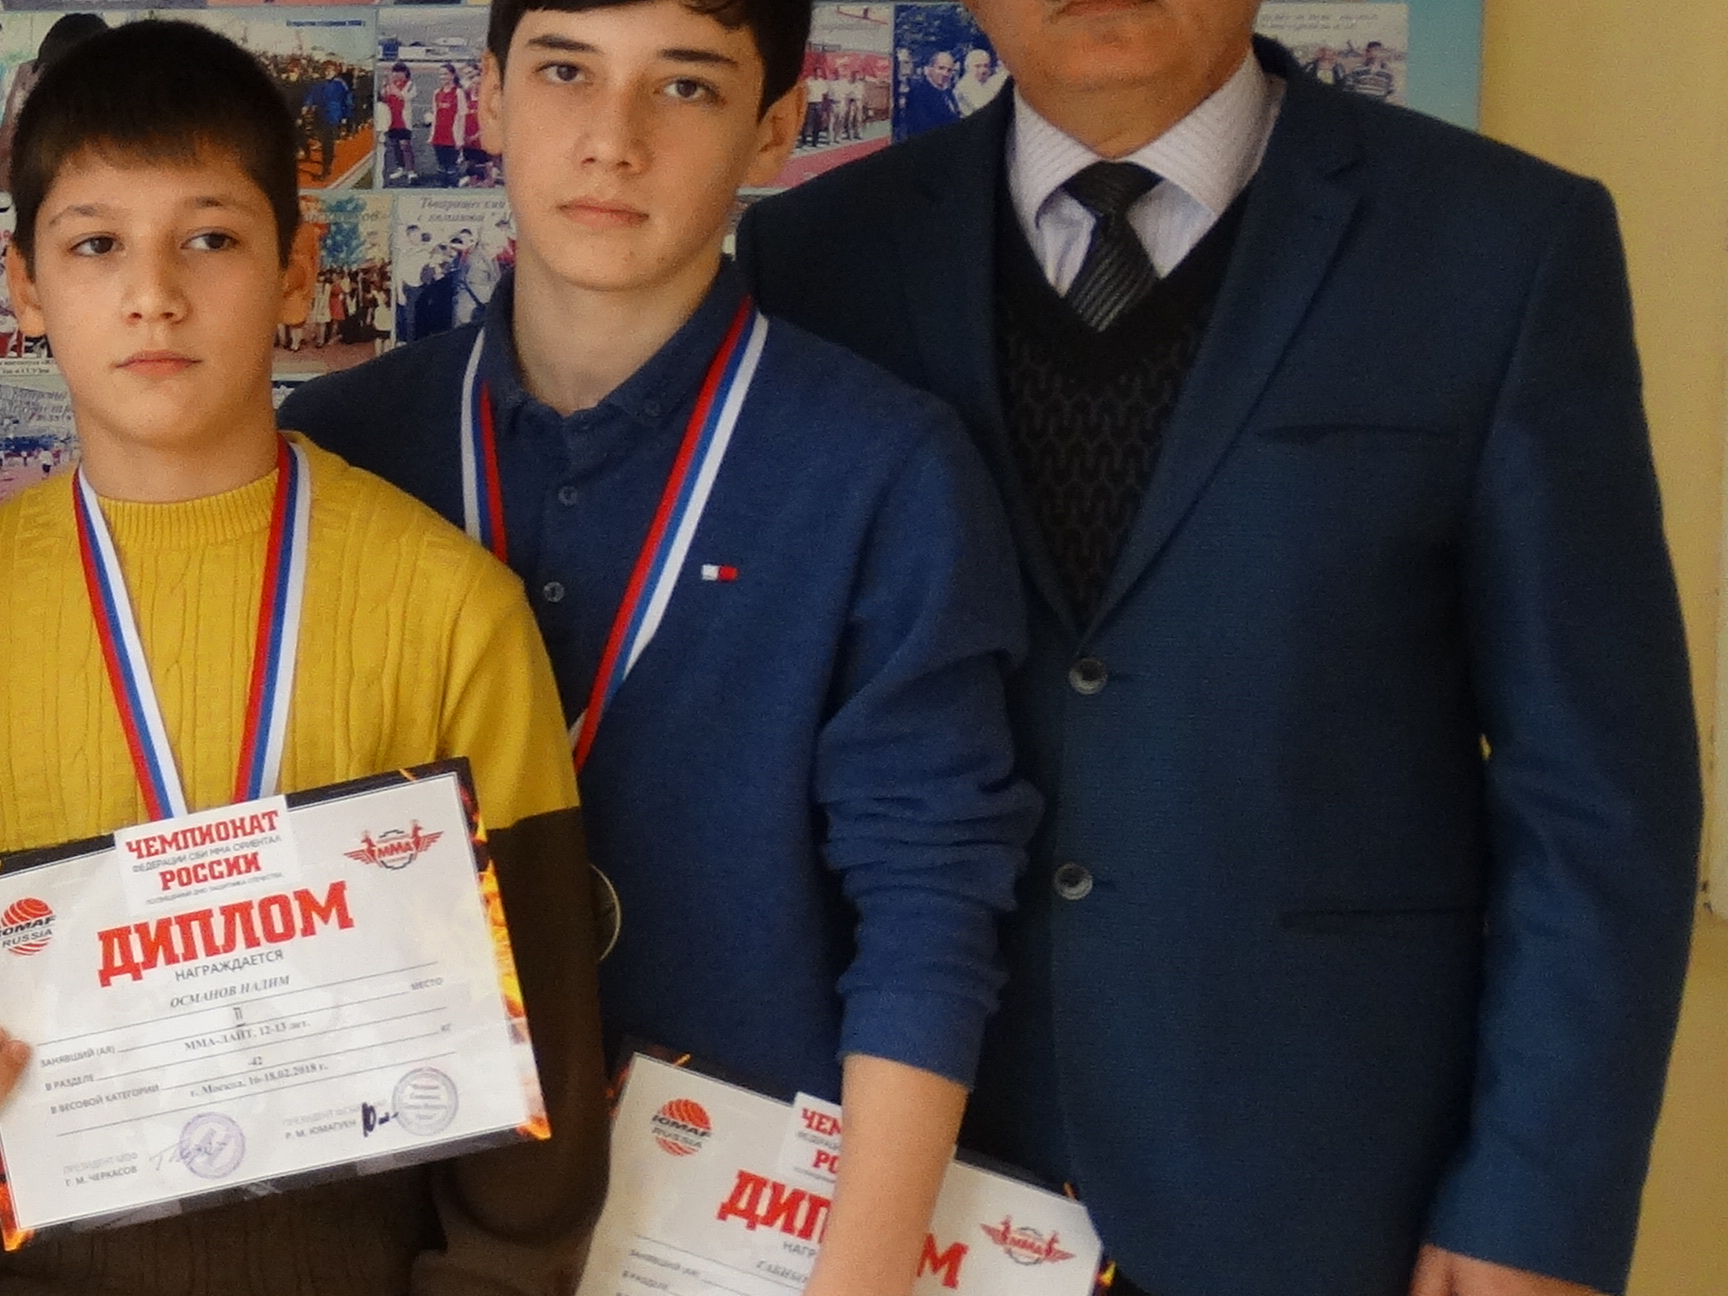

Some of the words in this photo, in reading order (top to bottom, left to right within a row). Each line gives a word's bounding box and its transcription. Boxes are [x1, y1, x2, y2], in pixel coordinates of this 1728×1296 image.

[125, 808, 280, 861] ЧЕМПИОНАТ
[132, 852, 188, 873] ФЕДЕРАЦИИ
[232, 835, 283, 854] ОРИЕНТАЛ
[159, 851, 262, 892] РОССИИ
[2, 928, 54, 948] RUSSIA
[97, 880, 355, 988] ДИПЛОМ
[175, 949, 284, 982] НАГРАЖДАЕТСЯ
[169, 982, 237, 1009] ОСМАНОВ
[239, 974, 291, 997] НАДИМ
[54, 1073, 95, 1090] РАЗДЕЛЕ
[104, 1084, 160, 1104] КАТЕГОРИИ
[87, 1165, 138, 1183] ЧЕРКАСОВ
